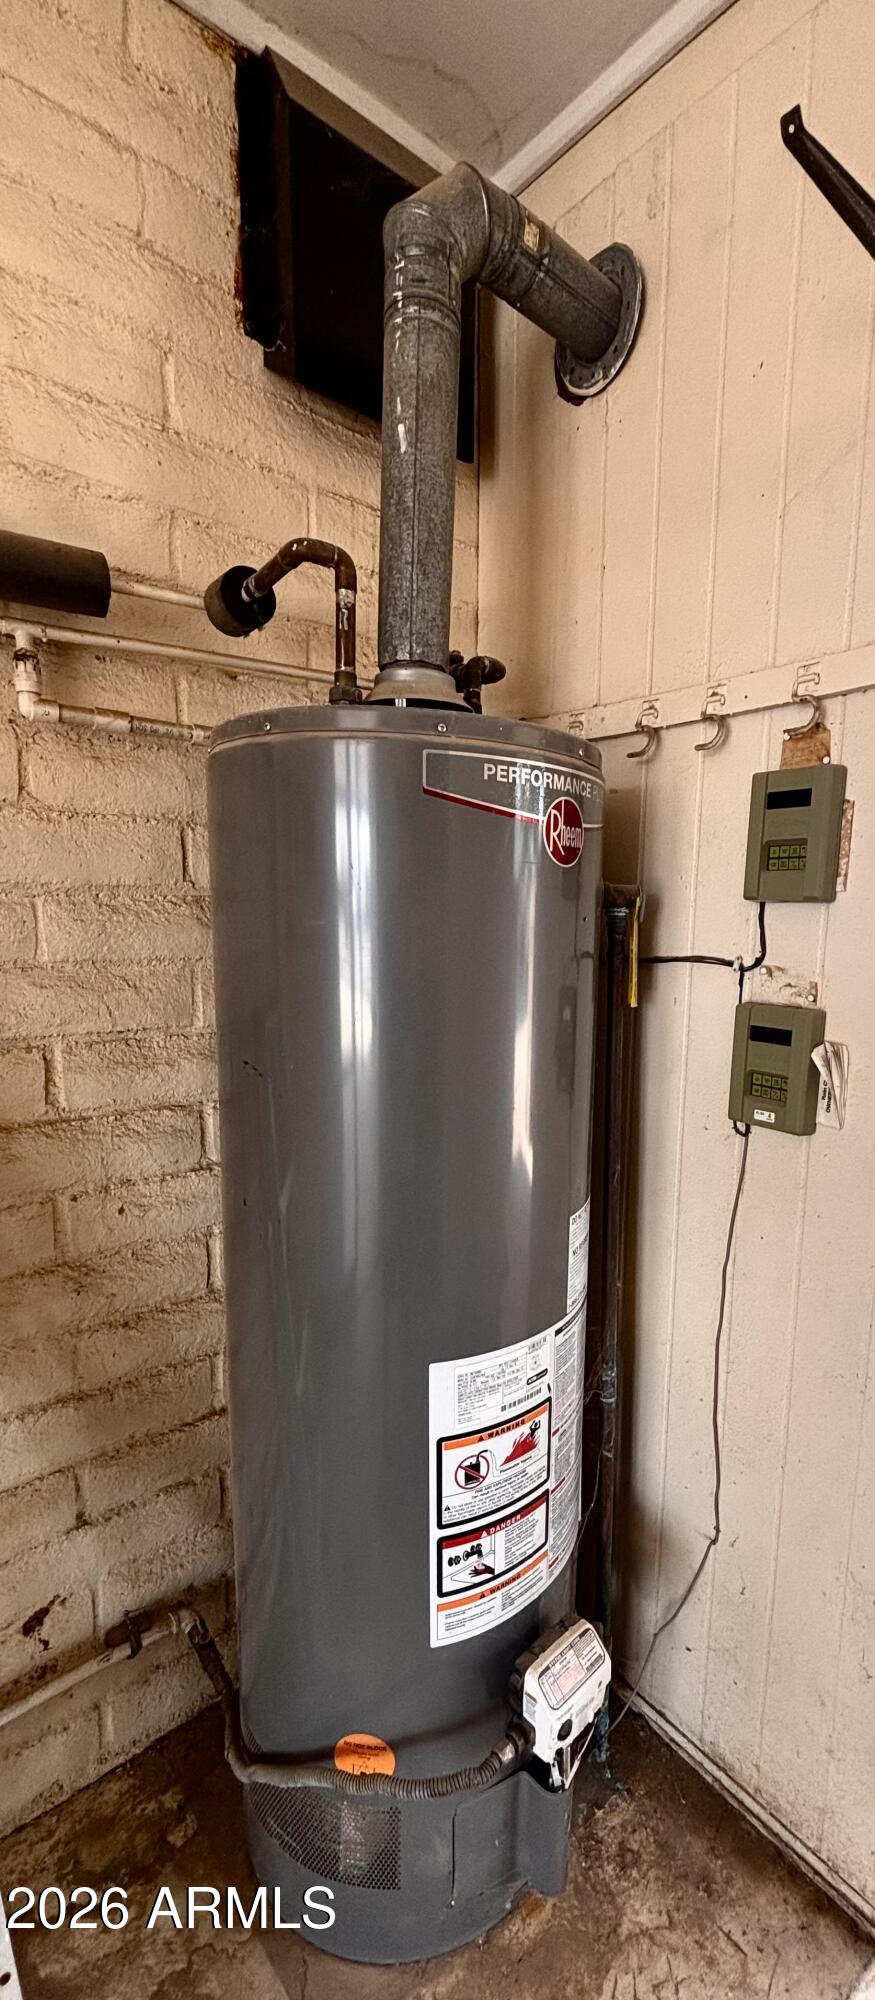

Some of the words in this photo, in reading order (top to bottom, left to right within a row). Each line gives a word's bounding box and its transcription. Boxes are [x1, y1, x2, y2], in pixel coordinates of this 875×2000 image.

[484, 763, 592, 797] PERFORMANCE
[549, 800, 582, 855] Rheem
[487, 1418, 527, 1439] WARNING
[489, 1514, 522, 1534] DANGER
[488, 1573, 521, 1595] WARNING
